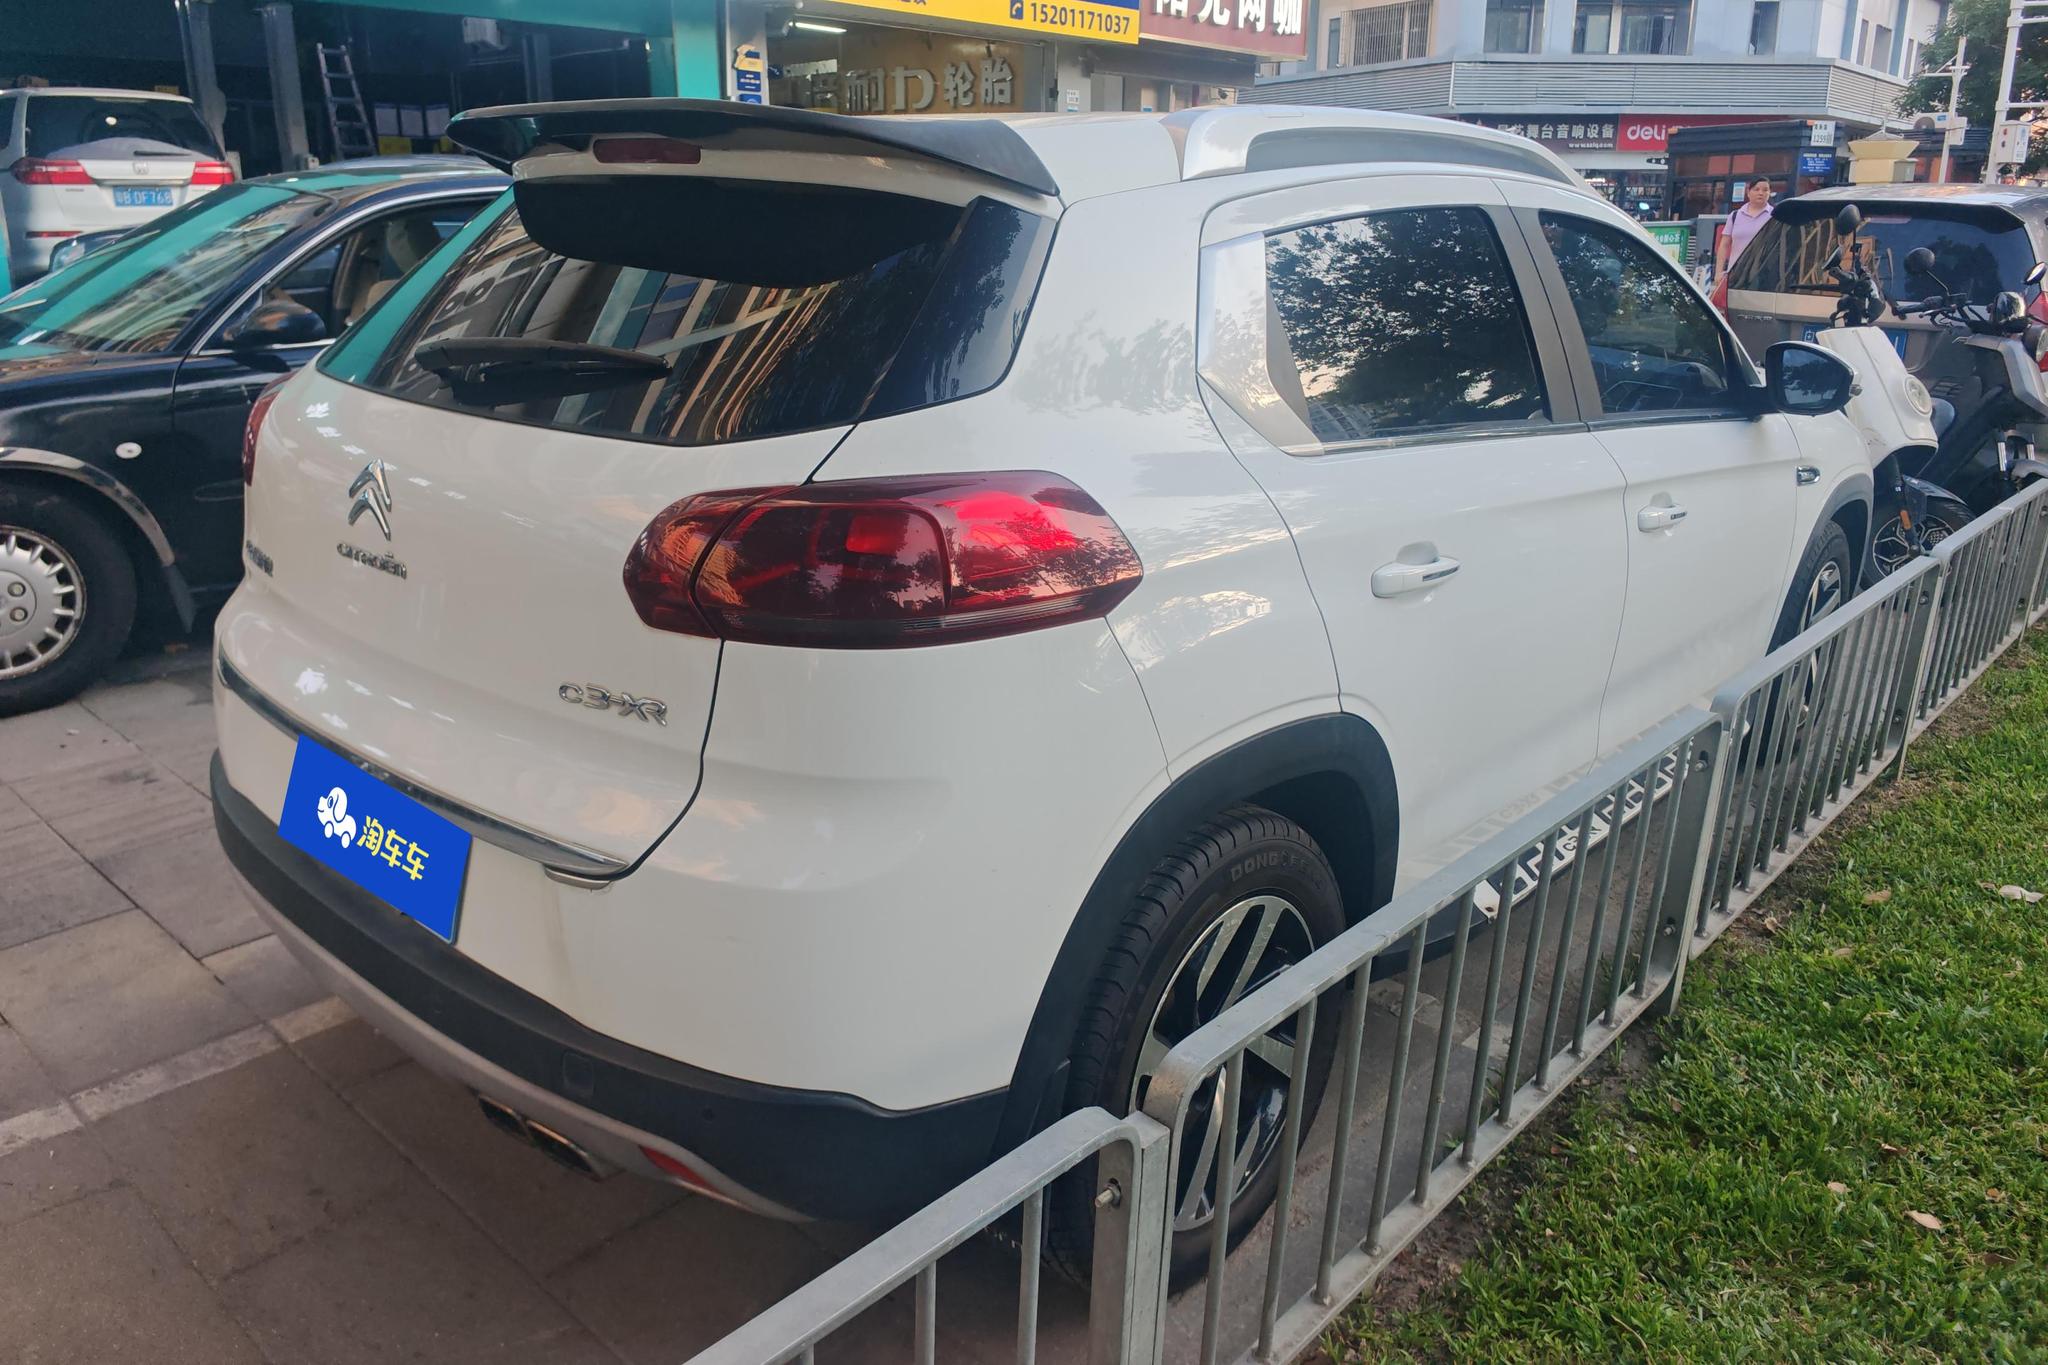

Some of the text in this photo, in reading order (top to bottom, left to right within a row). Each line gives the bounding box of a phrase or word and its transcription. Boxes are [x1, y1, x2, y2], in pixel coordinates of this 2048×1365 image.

[1031, 2, 1130, 35] 15201171037
[1626, 125, 1666, 141] deli
[559, 683, 667, 727] C3-XR
